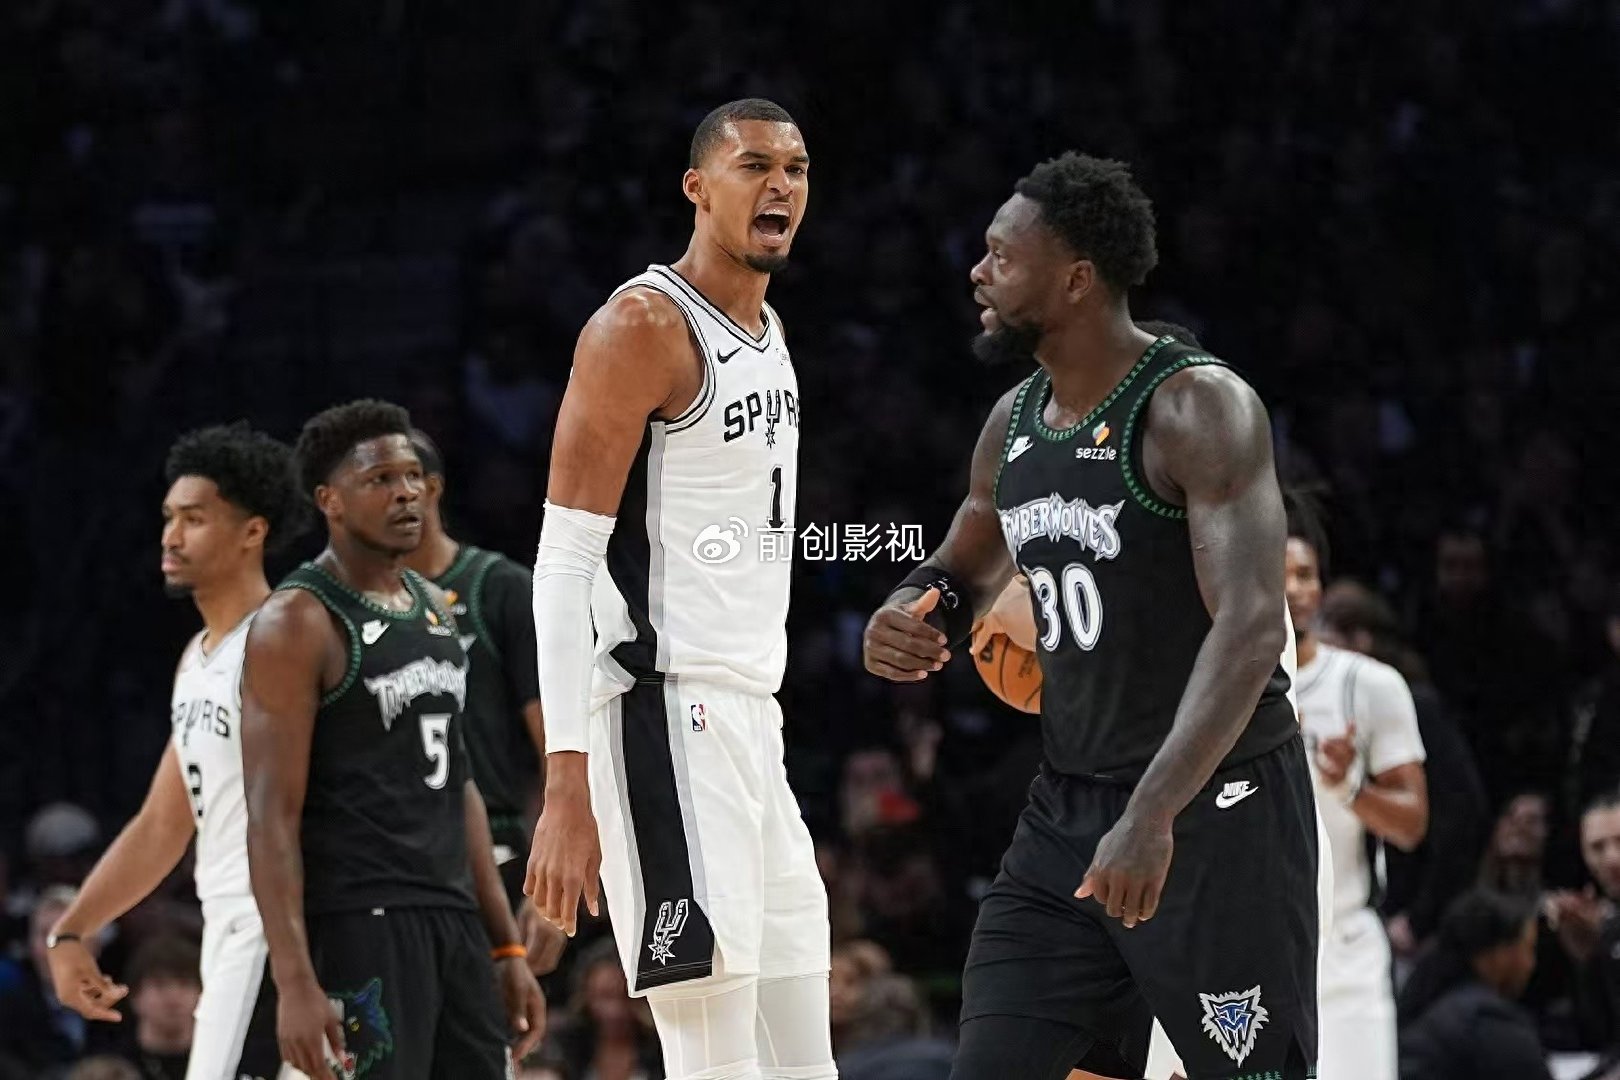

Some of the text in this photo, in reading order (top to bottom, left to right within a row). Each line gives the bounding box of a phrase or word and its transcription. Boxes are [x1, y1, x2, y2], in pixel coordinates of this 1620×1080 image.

[724, 389, 800, 449] SPUR
[1076, 447, 1117, 461] sezzle
[768, 465, 787, 534] 1
[1022, 562, 1104, 651] 30
[173, 699, 231, 746] PURS
[420, 713, 452, 790] 5
[1223, 781, 1250, 797] NIKE
